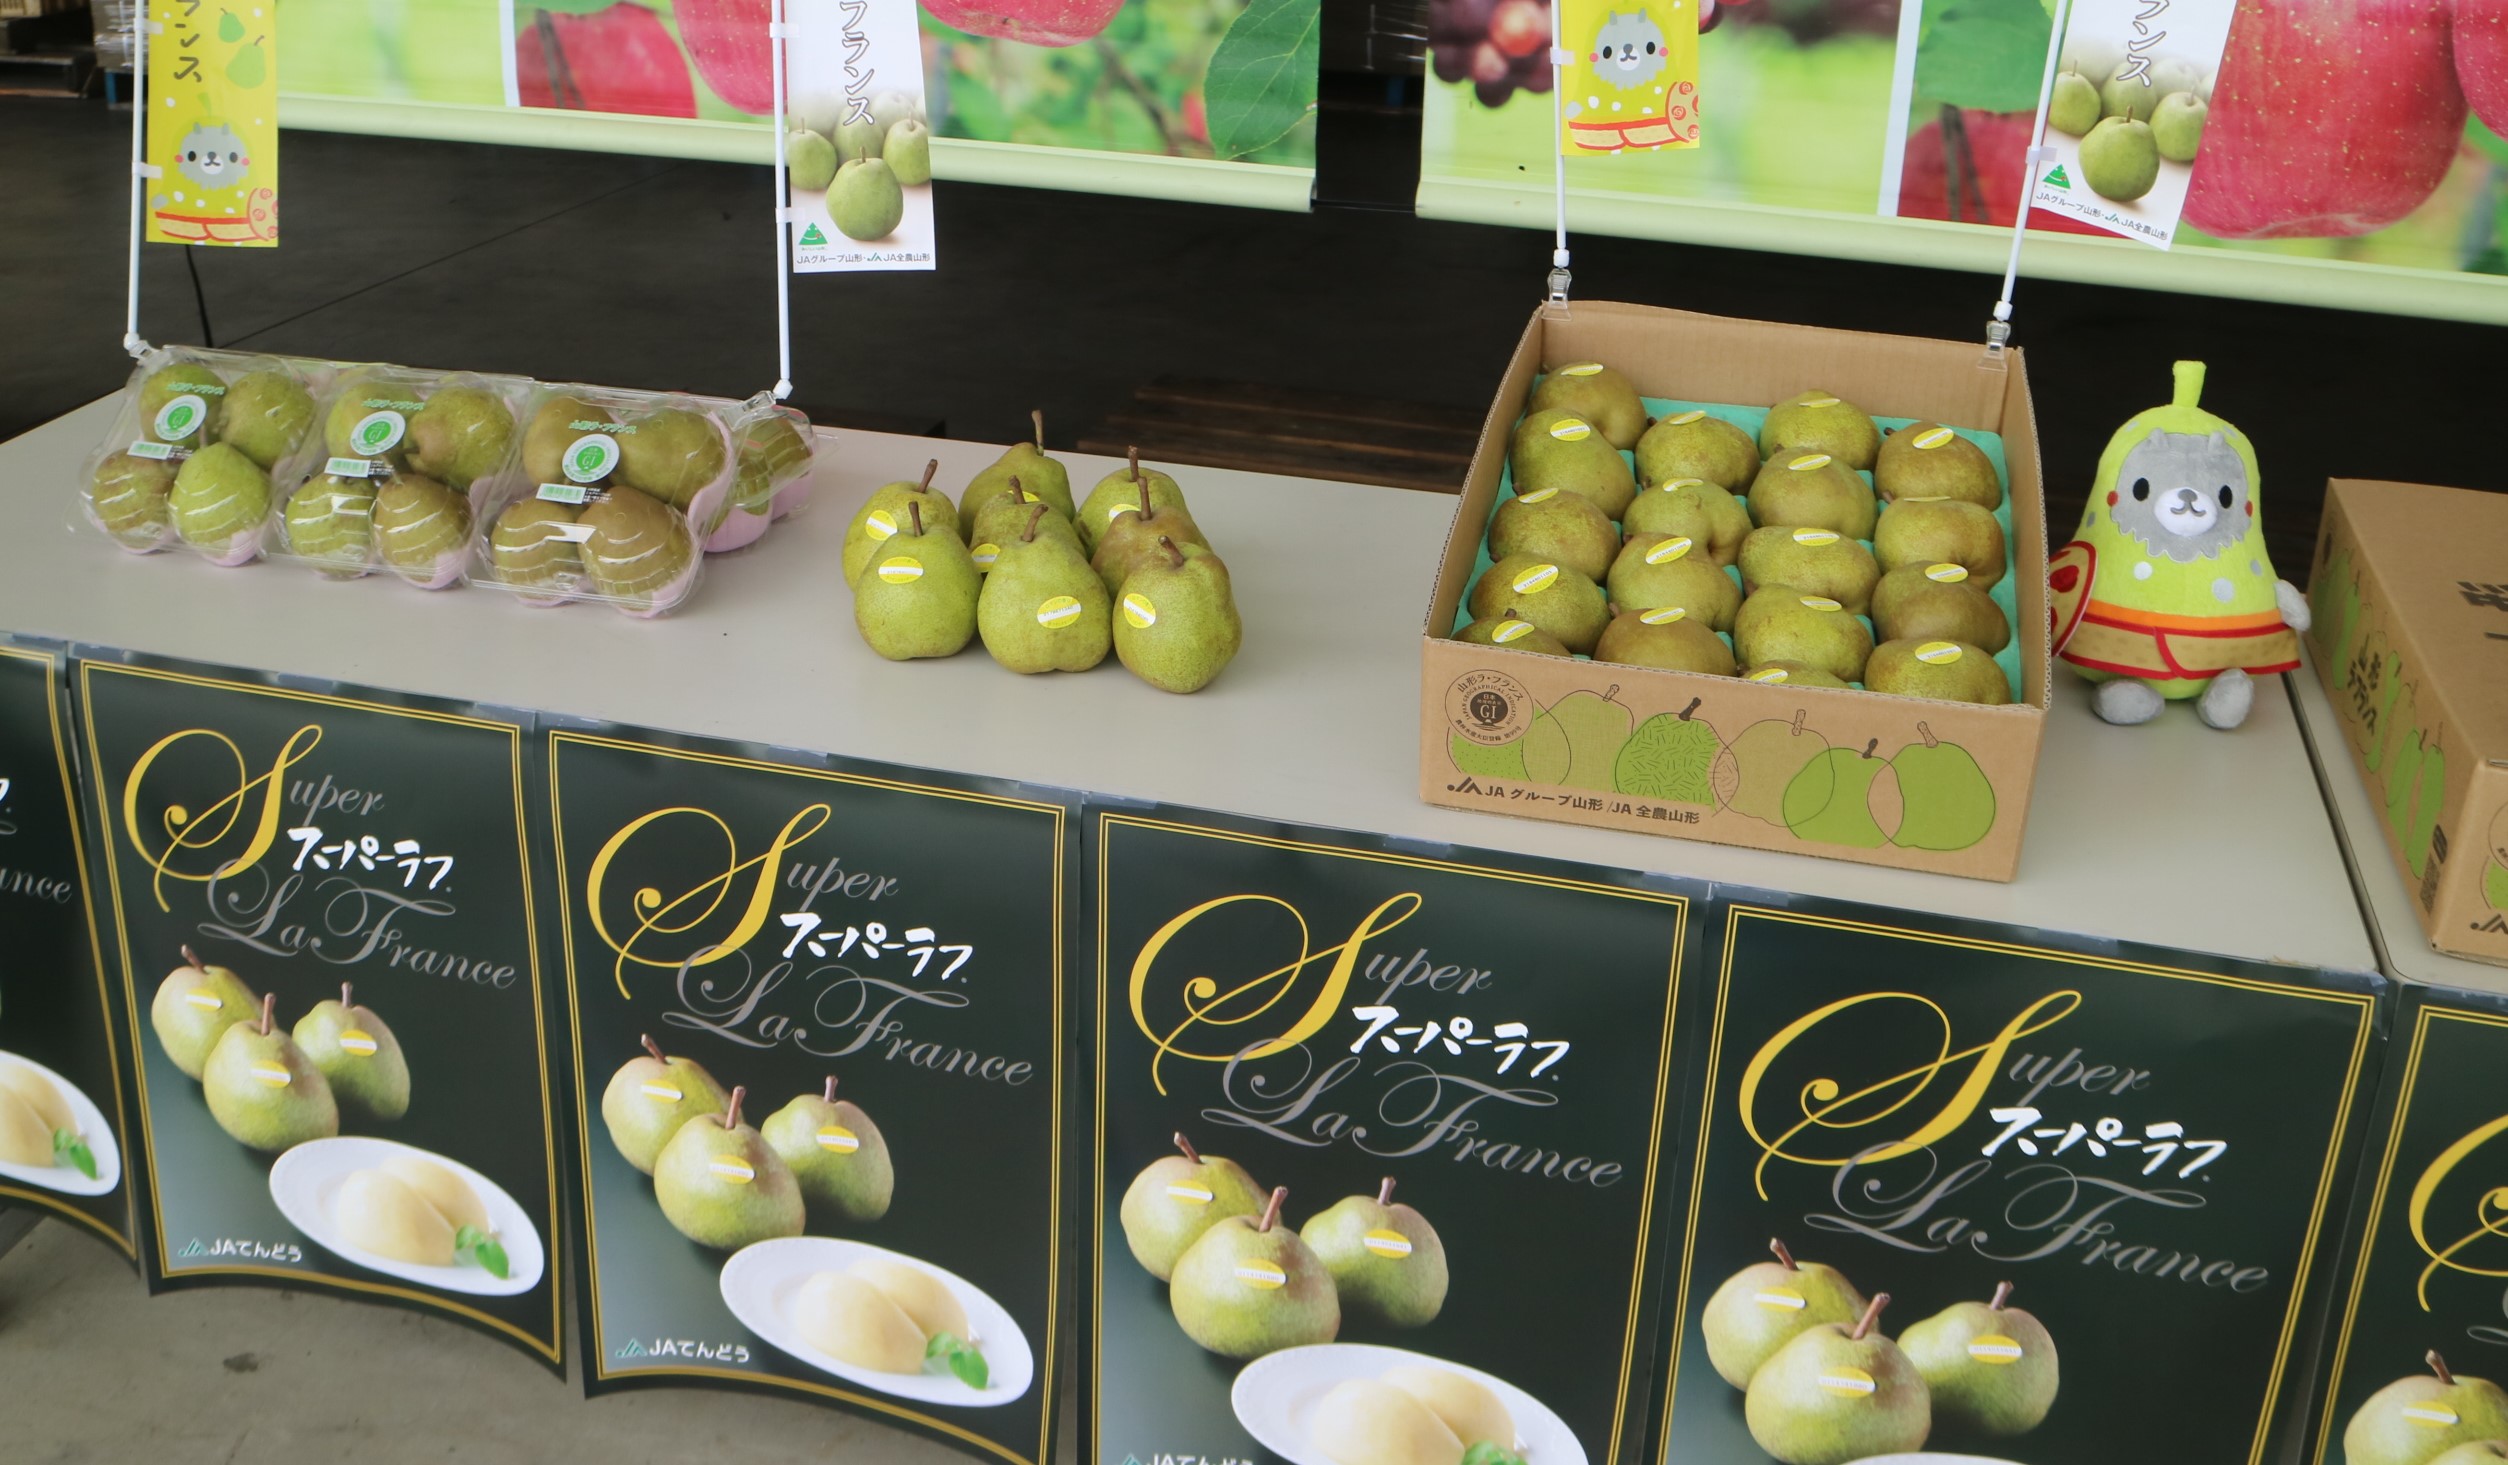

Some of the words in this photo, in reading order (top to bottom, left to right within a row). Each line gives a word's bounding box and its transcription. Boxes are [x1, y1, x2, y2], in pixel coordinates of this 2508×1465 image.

[839, 0, 875, 127] フランス
[1480, 704, 1497, 719] GI
[123, 724, 385, 912] Super
[1635, 804, 1701, 825] 全農山形
[197, 858, 312, 958] La
[310, 876, 518, 990] France
[587, 804, 899, 1000] Super
[661, 944, 796, 1049] La
[793, 965, 1034, 1086] France
[1129, 892, 1493, 1097] Super
[1200, 1037, 1356, 1148] La
[1352, 1060, 1624, 1188] France
[1738, 989, 2152, 1202] Super
[210, 1237, 302, 1263] JAてんどう
[1803, 1140, 1975, 1254] La
[1970, 1163, 2269, 1294] France
[649, 1337, 750, 1363] JAてんどう
